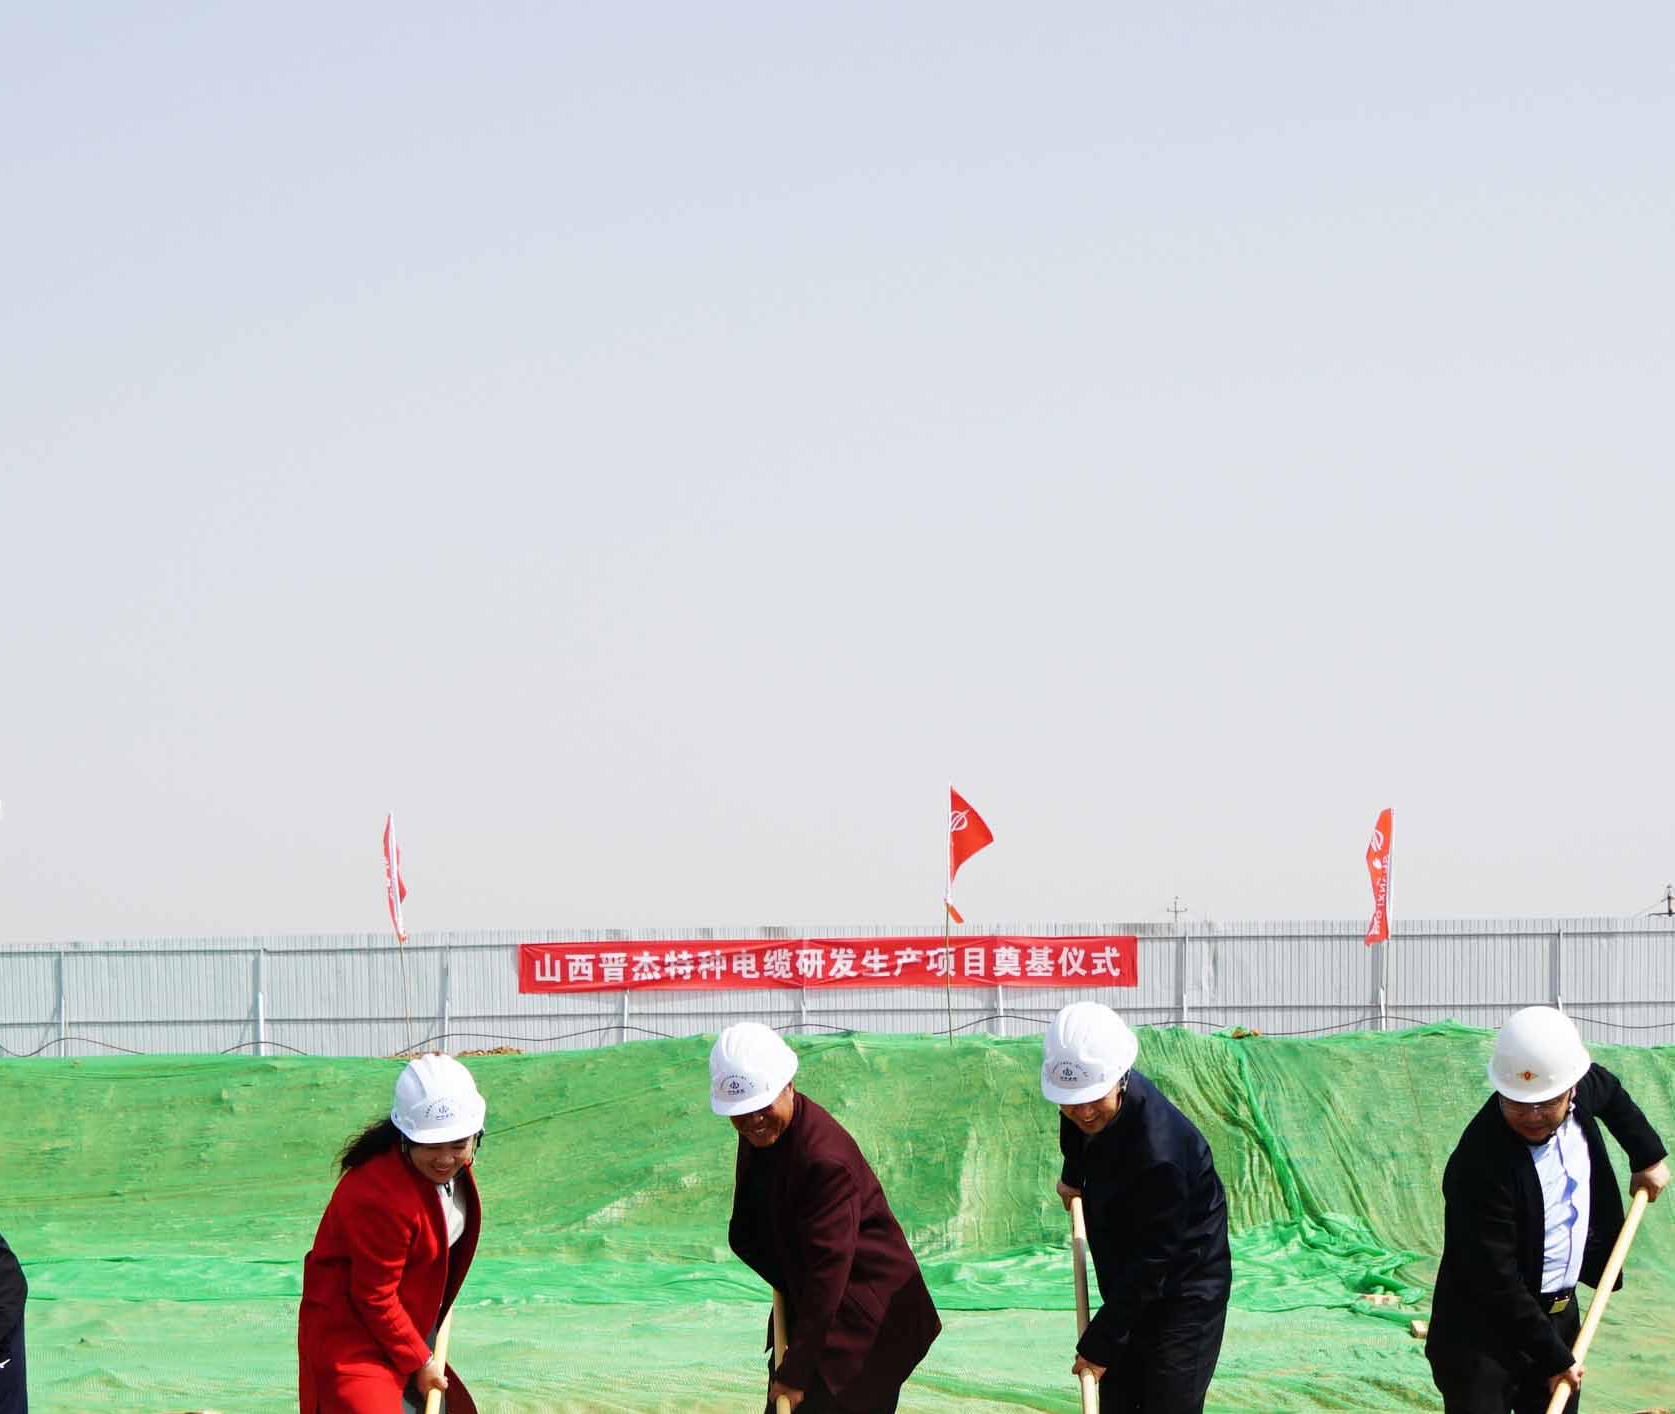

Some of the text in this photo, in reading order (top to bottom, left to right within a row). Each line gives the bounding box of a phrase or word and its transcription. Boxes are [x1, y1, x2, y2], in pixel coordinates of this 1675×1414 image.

[533, 944, 1122, 984] 山西晋杰特种电缆研发生产项目奠基仪式
